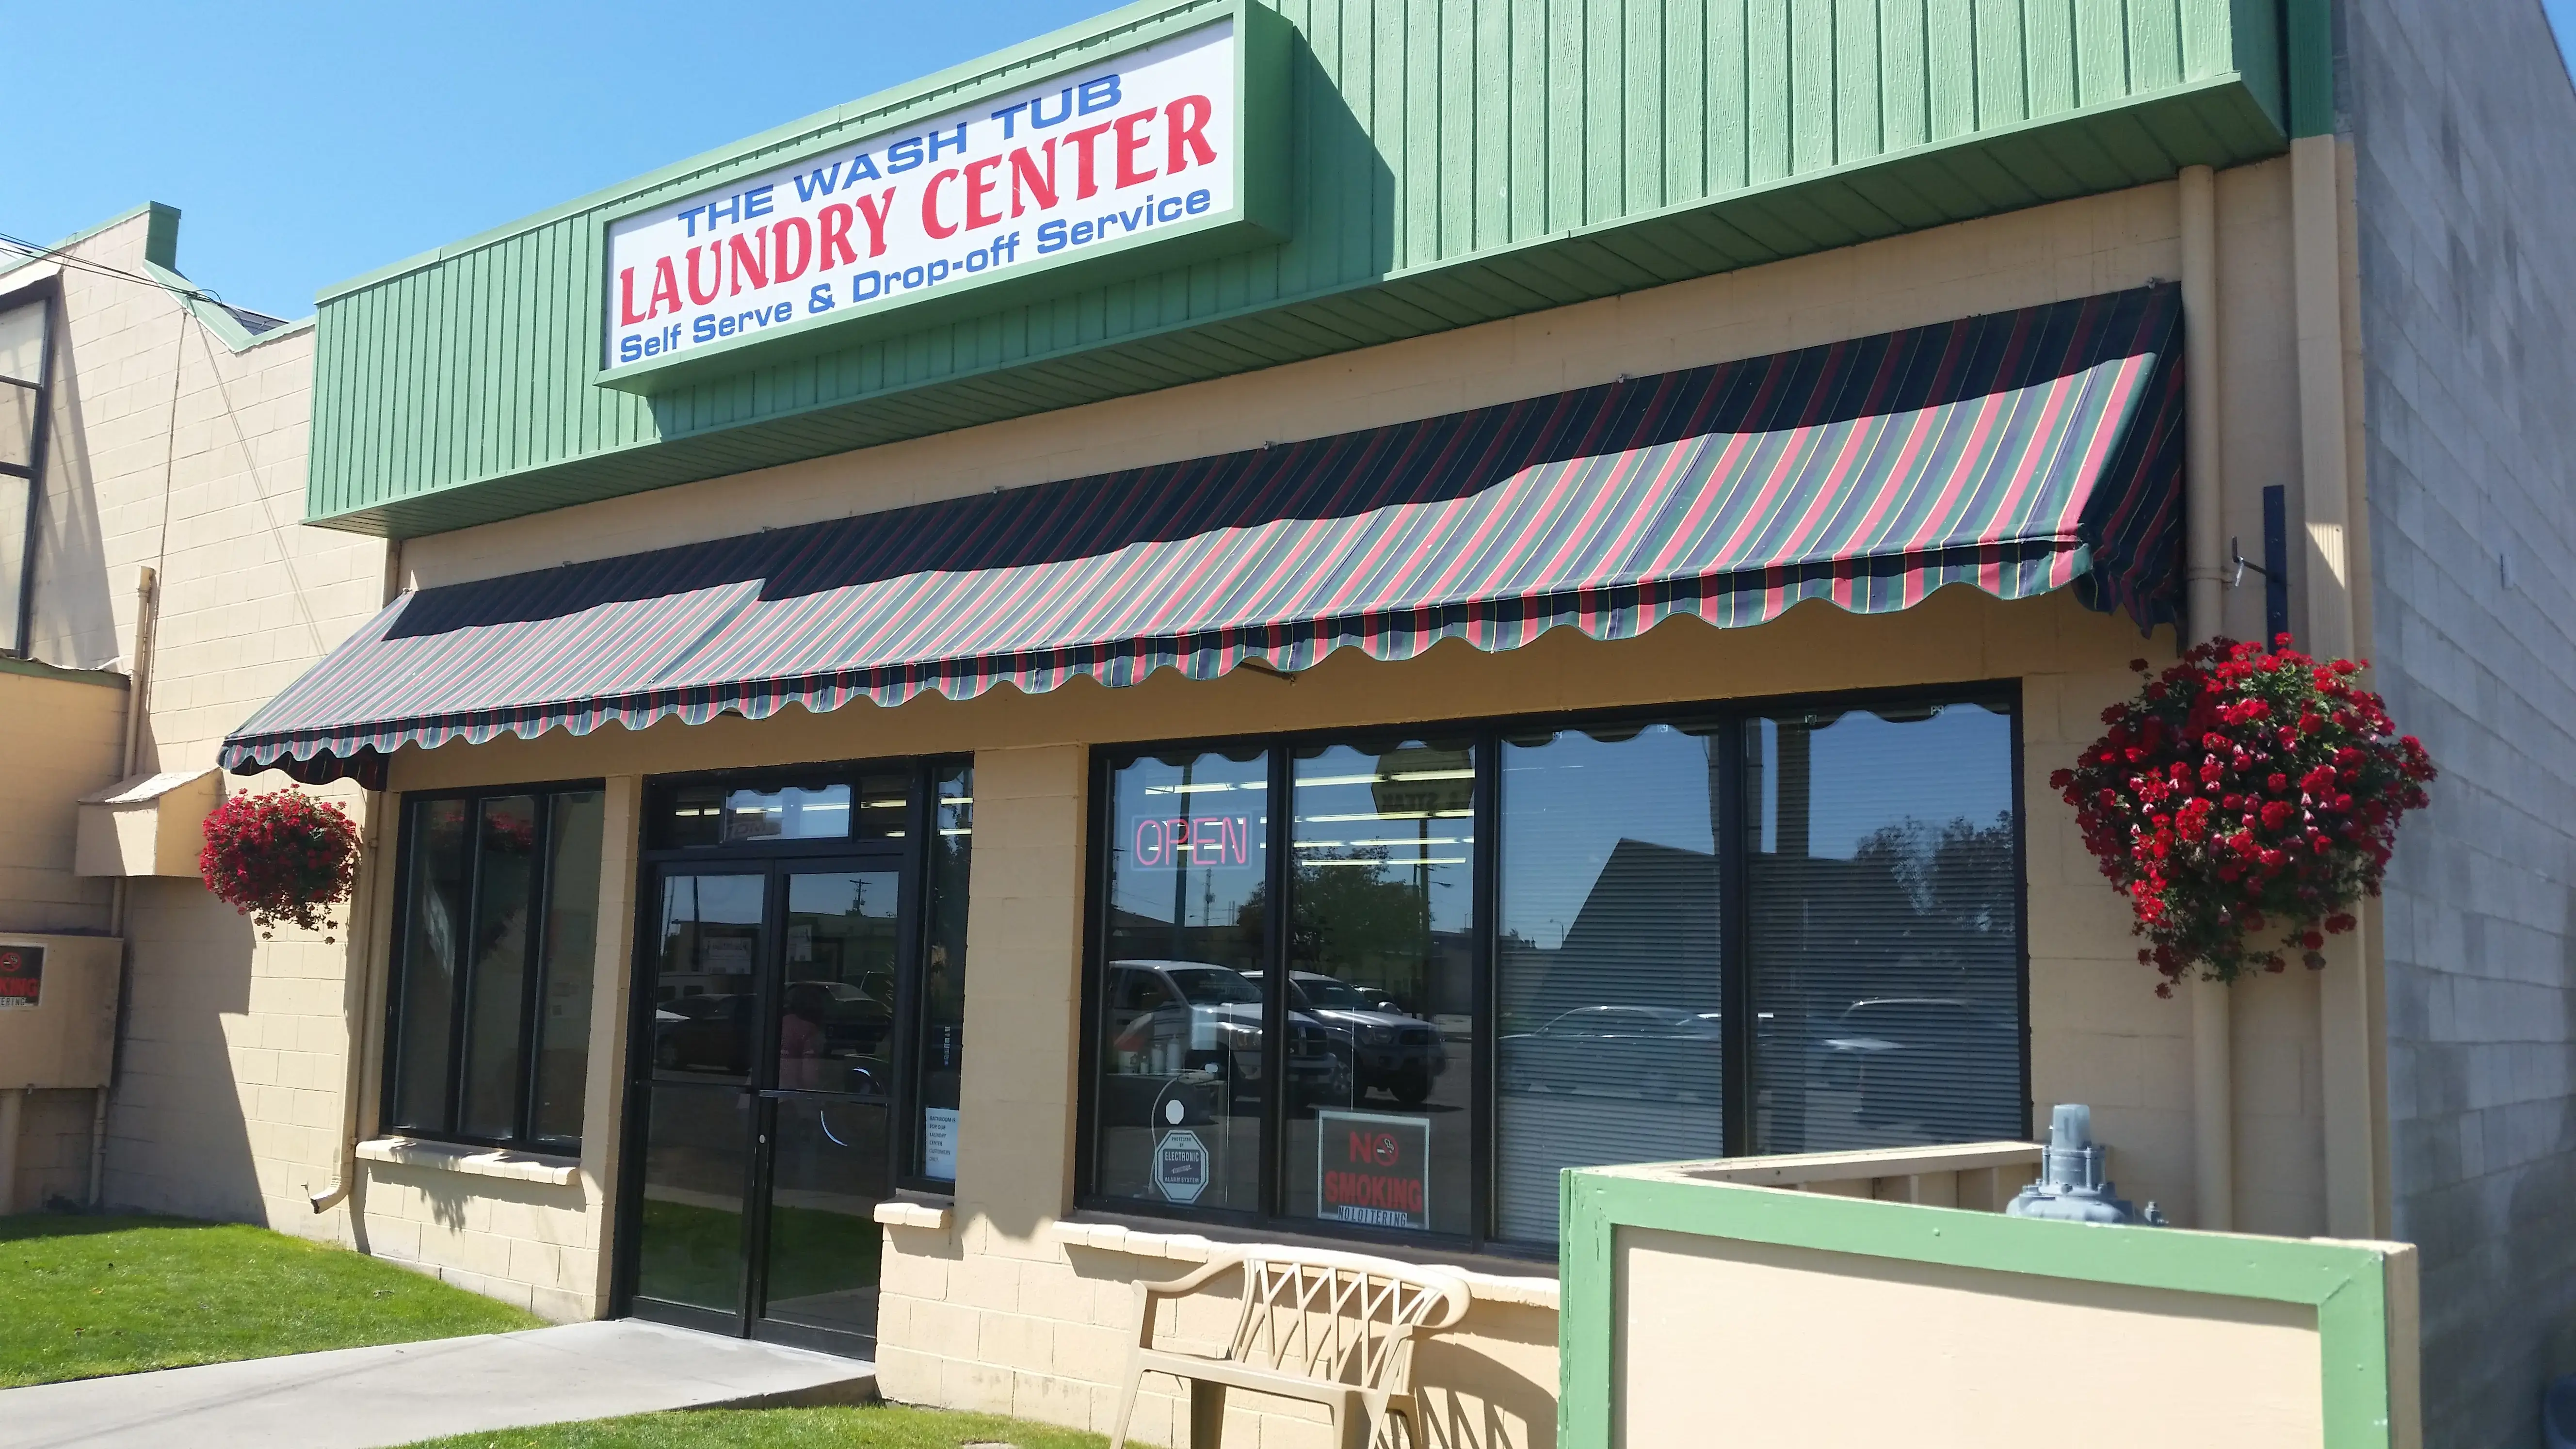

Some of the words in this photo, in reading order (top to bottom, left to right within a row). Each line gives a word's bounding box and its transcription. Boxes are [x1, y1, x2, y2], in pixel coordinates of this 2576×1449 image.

[677, 181, 774, 237] THE
[793, 121, 967, 202] WASH
[989, 68, 1122, 139] TUB
[620, 188, 895, 326] LAUNDRY
[922, 95, 1216, 239] CENTER
[620, 323, 681, 359] Self
[693, 301, 792, 341] Serve
[808, 283, 835, 312] &
[853, 231, 1020, 301] Drop-off
[1037, 189, 1211, 253] Service
[1136, 817, 1246, 865] OPEN
[1165, 1151, 1199, 1162] ELECTRONIC
[1350, 1131, 1399, 1166] NO
[1325, 1170, 1422, 1213] SMOKING
